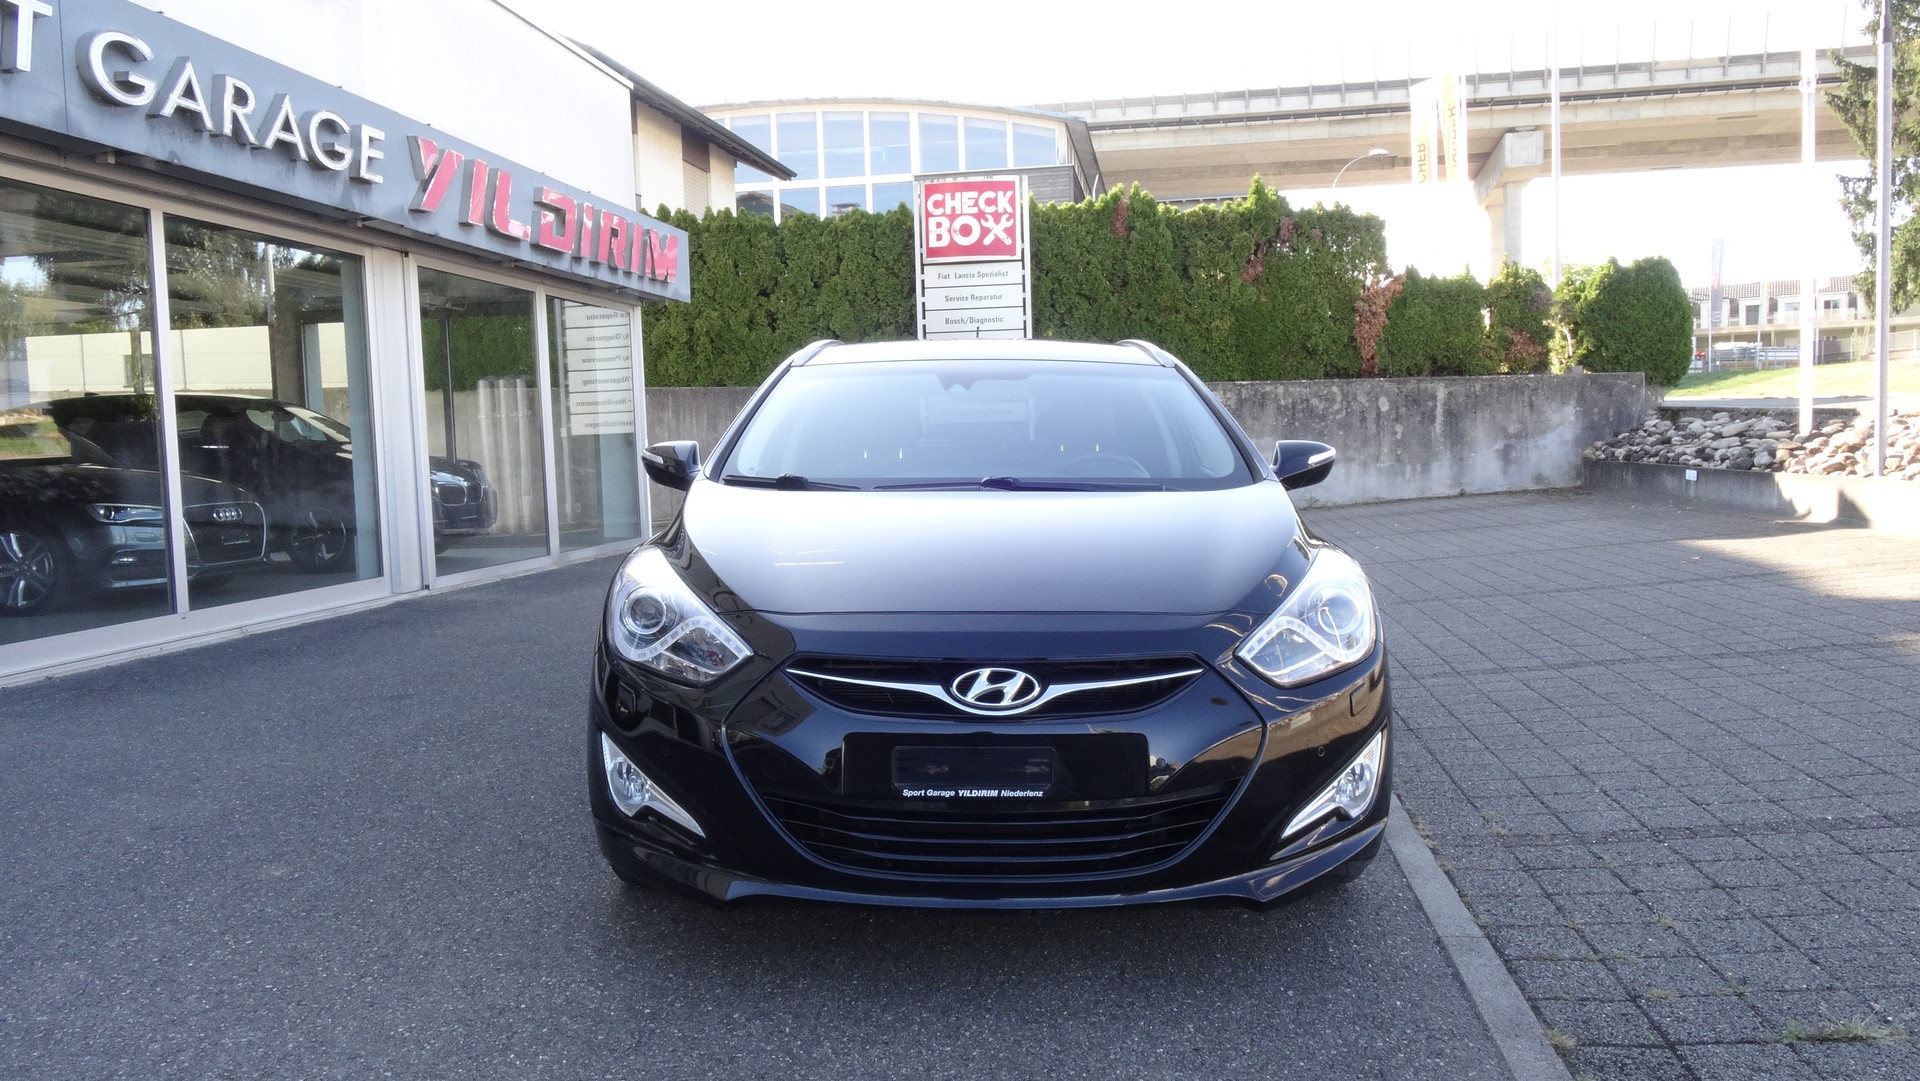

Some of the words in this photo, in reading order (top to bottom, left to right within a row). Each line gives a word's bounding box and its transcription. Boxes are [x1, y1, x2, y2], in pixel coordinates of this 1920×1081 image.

[78, 30, 386, 184] GARAGE
[407, 135, 679, 282] YILDIRIM
[927, 190, 1014, 215] CHECK
[954, 271, 975, 279] Lancia
[976, 270, 1009, 278] Spezialist
[944, 294, 969, 303] Service
[970, 293, 1003, 302] Reparatur
[944, 316, 1004, 325] Bosch/Diagnostic
[902, 789, 925, 798] Sport
[926, 789, 955, 798] Garage
[958, 789, 999, 798] YILDIRIM
[1000, 789, 1044, 798] Niederlenz
